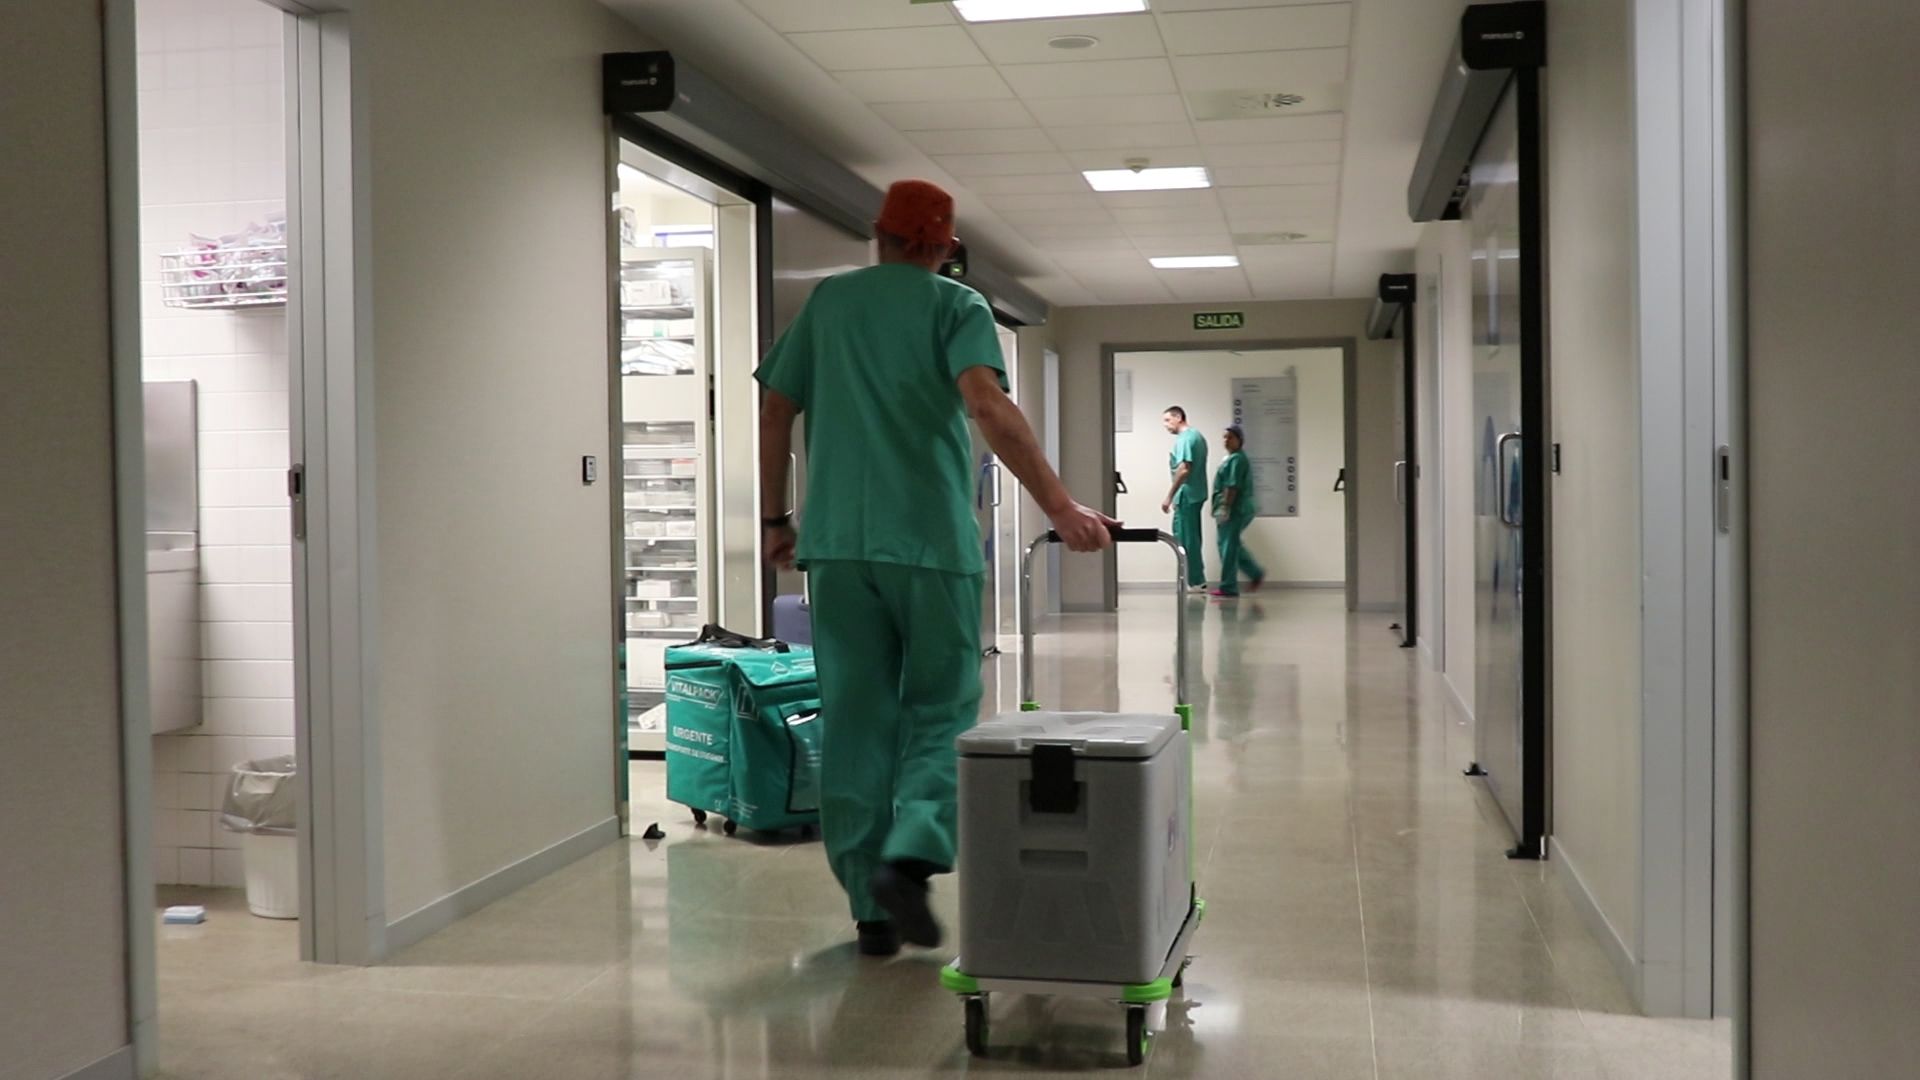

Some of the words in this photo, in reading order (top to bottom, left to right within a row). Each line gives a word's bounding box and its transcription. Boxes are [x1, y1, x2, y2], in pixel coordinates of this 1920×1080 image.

[1197, 314, 1241, 327] SALIDA
[671, 681, 720, 700] VITALPACK
[672, 725, 713, 746] URGENTE
